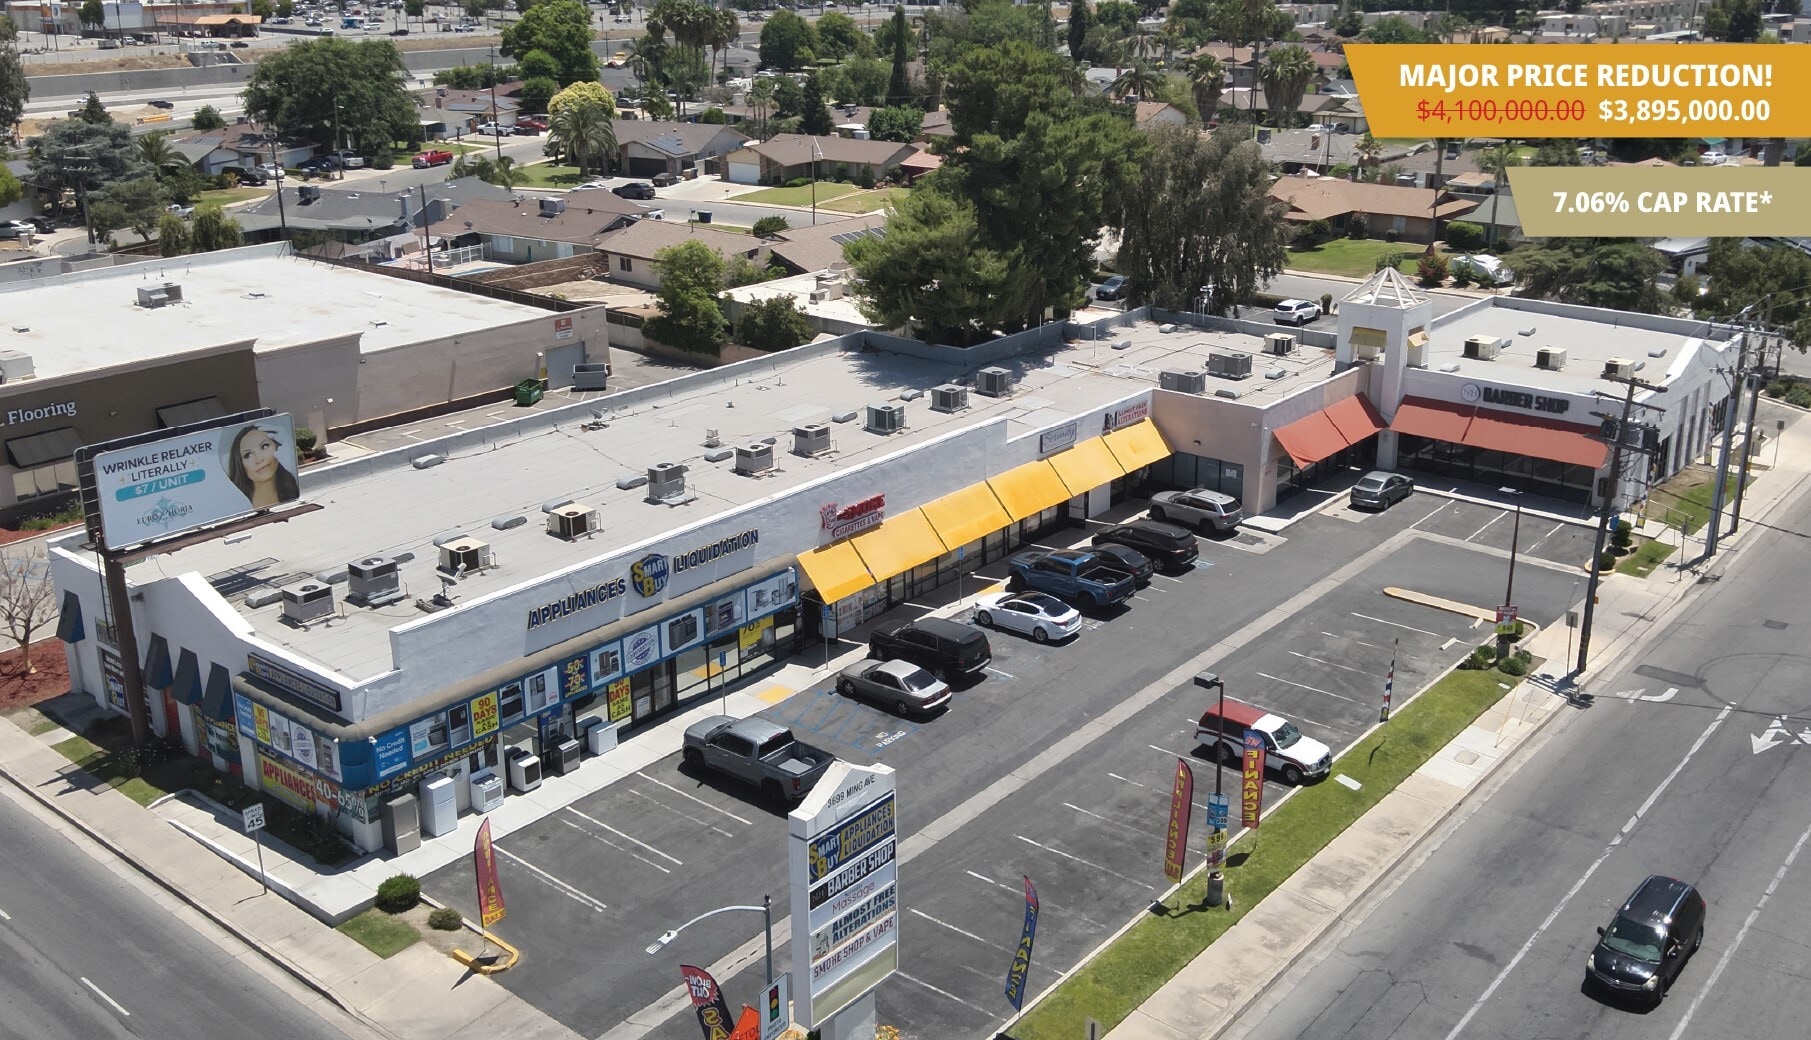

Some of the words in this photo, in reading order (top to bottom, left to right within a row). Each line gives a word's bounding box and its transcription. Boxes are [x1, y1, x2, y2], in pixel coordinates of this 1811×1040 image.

[7, 402, 77, 424] Flooring
[1483, 387, 1533, 409] BARBER
[1534, 396, 1569, 414] SHOP
[103, 452, 159, 476] WRINKLE
[161, 441, 213, 463] RELAXER
[131, 460, 188, 482] LITERALLY
[159, 474, 189, 490] UNIT
[835, 519, 866, 537] CIGARETTES
[673, 528, 759, 573] LIQUIDATION
[633, 556, 668, 582] SMART
[643, 575, 668, 597] BUY
[528, 577, 626, 630] APPLIANCES
[478, 697, 490, 709] 90
[609, 685, 630, 702] DAYS
[474, 705, 497, 721] DAYS
[611, 706, 631, 718] CASH
[476, 722, 498, 734] CASH
[376, 745, 386, 753] No
[387, 738, 405, 749] Credit
[379, 745, 403, 759] Needed
[369, 780, 390, 794] NO
[395, 759, 438, 781] CREDIT
[444, 736, 493, 761] NEEDED
[263, 761, 316, 801] APPLIANCES
[827, 791, 845, 808] 3699
[846, 781, 863, 798] MING
[864, 774, 876, 788] AVE
[248, 817, 263, 829] 45
[844, 804, 891, 841] APPLIANCES
[844, 816, 894, 855] LIQUIDATION
[809, 833, 841, 864] SMART
[817, 852, 840, 878] BUY
[827, 858, 868, 897] BARBER
[868, 842, 894, 871] SHOP
[832, 882, 875, 914] Massage
[832, 897, 873, 933] ALMOST
[874, 885, 895, 906] FREE
[832, 897, 895, 944] ALTERATIONS
[814, 952, 841, 978] SMOKE
[843, 938, 865, 958] SHOP
[866, 933, 871, 942] &
[873, 916, 894, 938] VAPE
